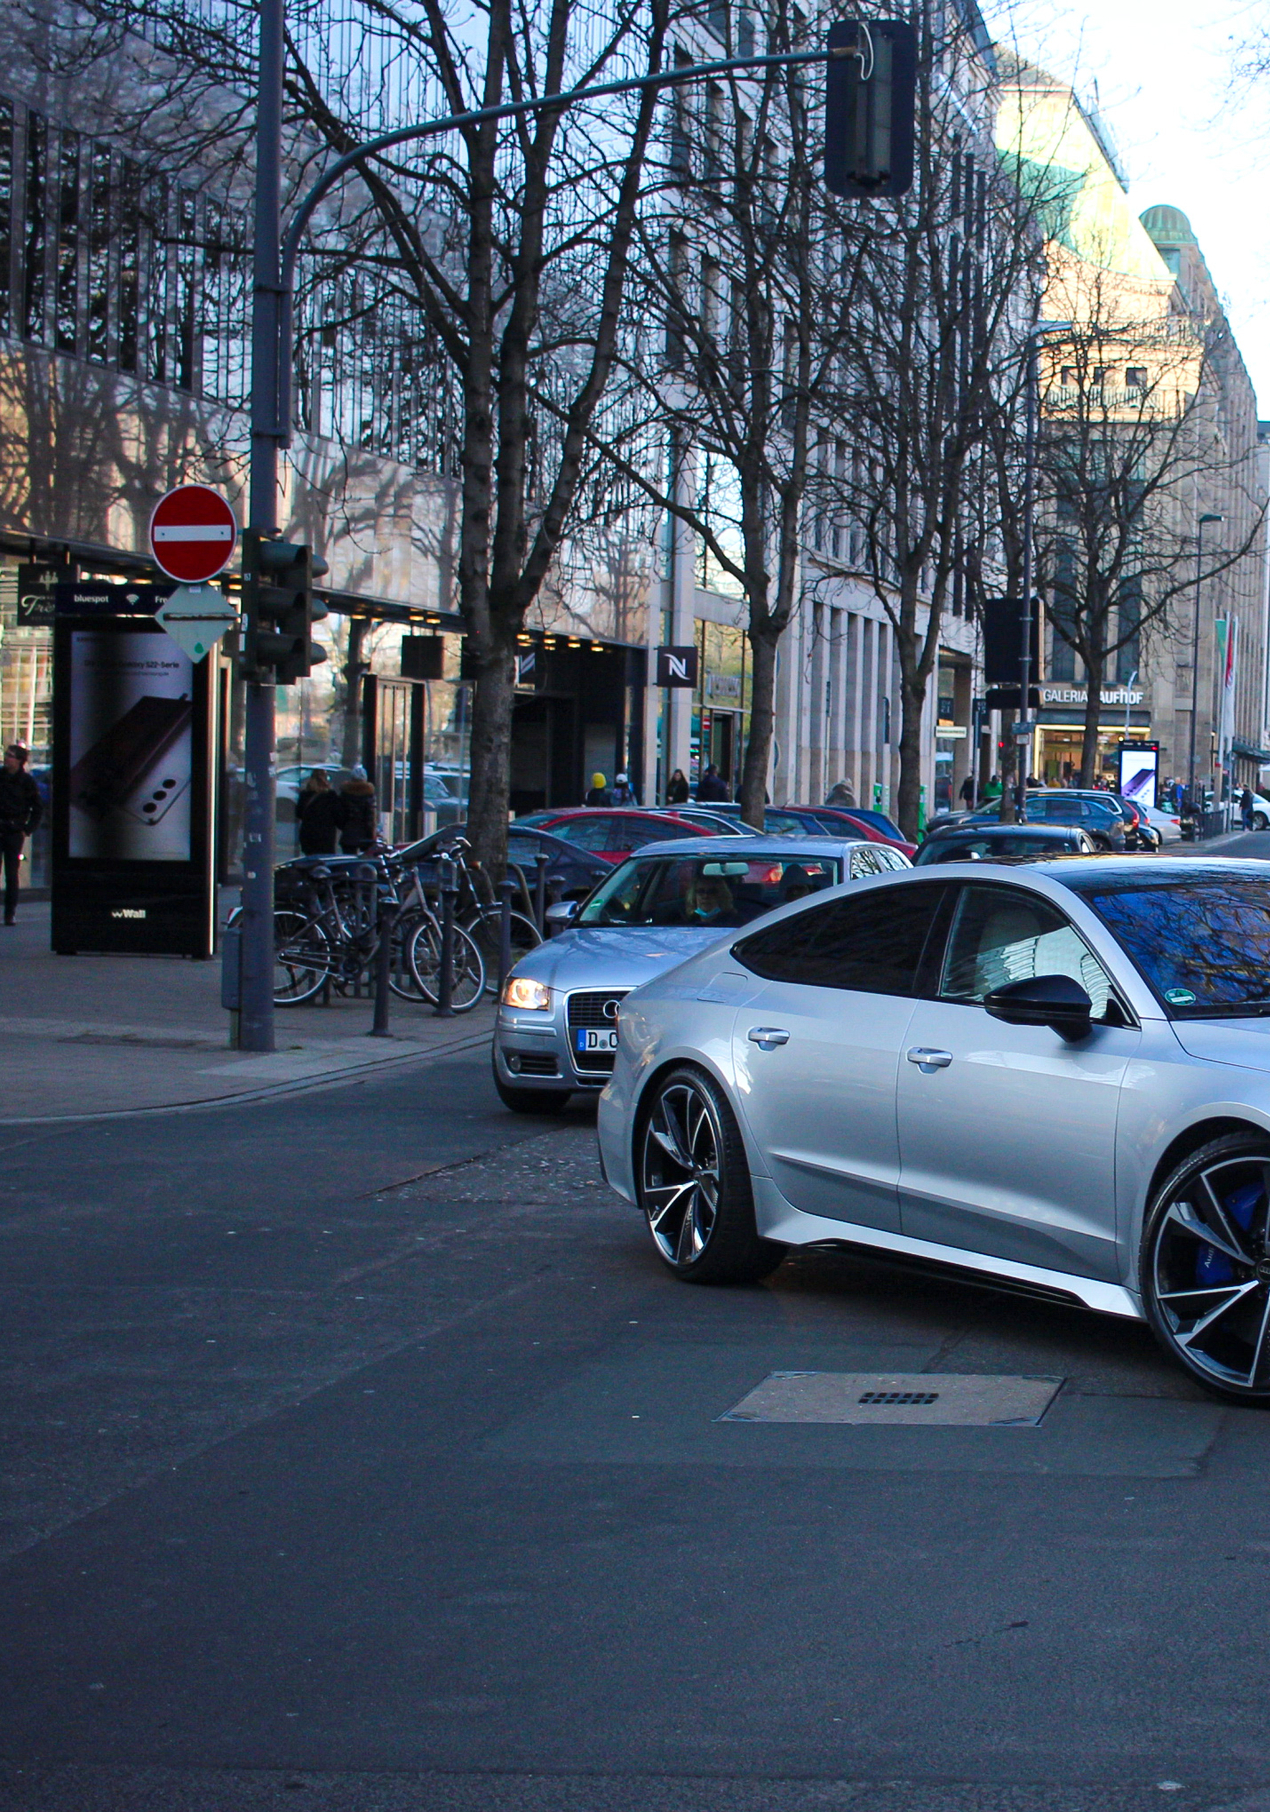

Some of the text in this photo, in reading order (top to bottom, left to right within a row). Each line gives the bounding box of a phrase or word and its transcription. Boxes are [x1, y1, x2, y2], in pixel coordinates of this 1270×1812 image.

[74, 594, 168, 604] bluespot Fre
[1043, 689, 1088, 703] GALERIA
[122, 908, 146, 919] Wall
[588, 1031, 598, 1048] D
